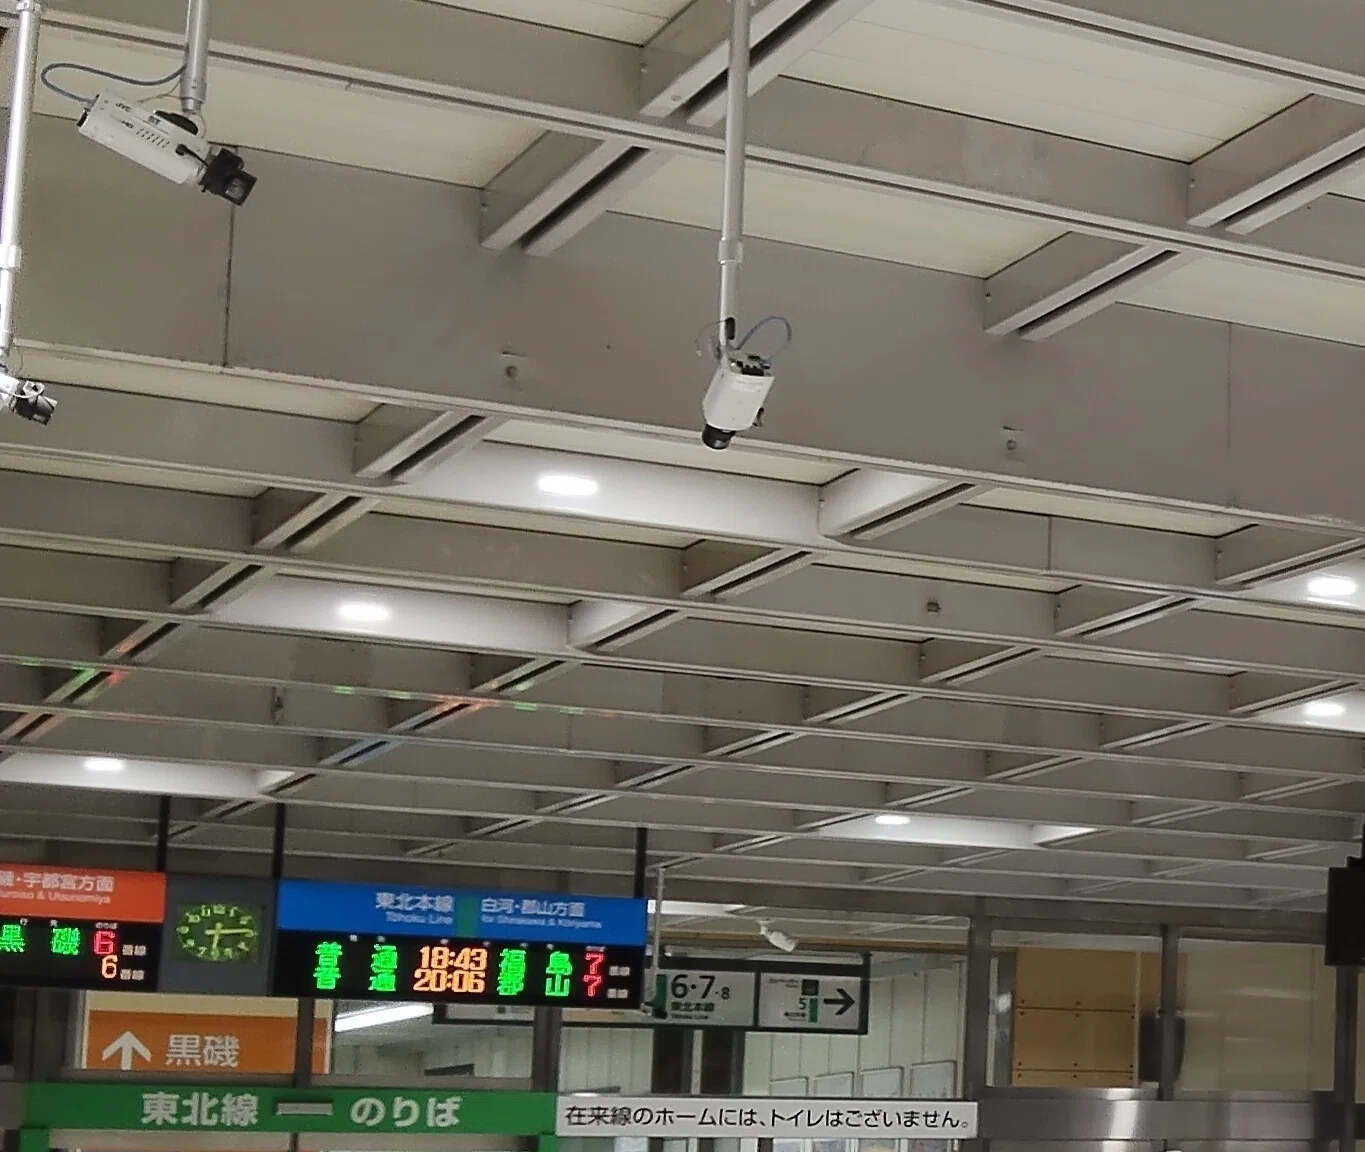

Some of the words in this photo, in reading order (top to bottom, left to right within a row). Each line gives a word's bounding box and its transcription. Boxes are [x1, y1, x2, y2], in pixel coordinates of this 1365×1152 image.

[101, 954, 118, 979] 6
[418, 945, 488, 970] 18:43
[412, 968, 486, 994] 20:06
[165, 1034, 240, 1068] 黒磯
[141, 1091, 260, 1127] 東北線
[350, 1096, 462, 1128] のりば
[564, 1105, 970, 1130] 在来線のホームには、トイレはございません。
